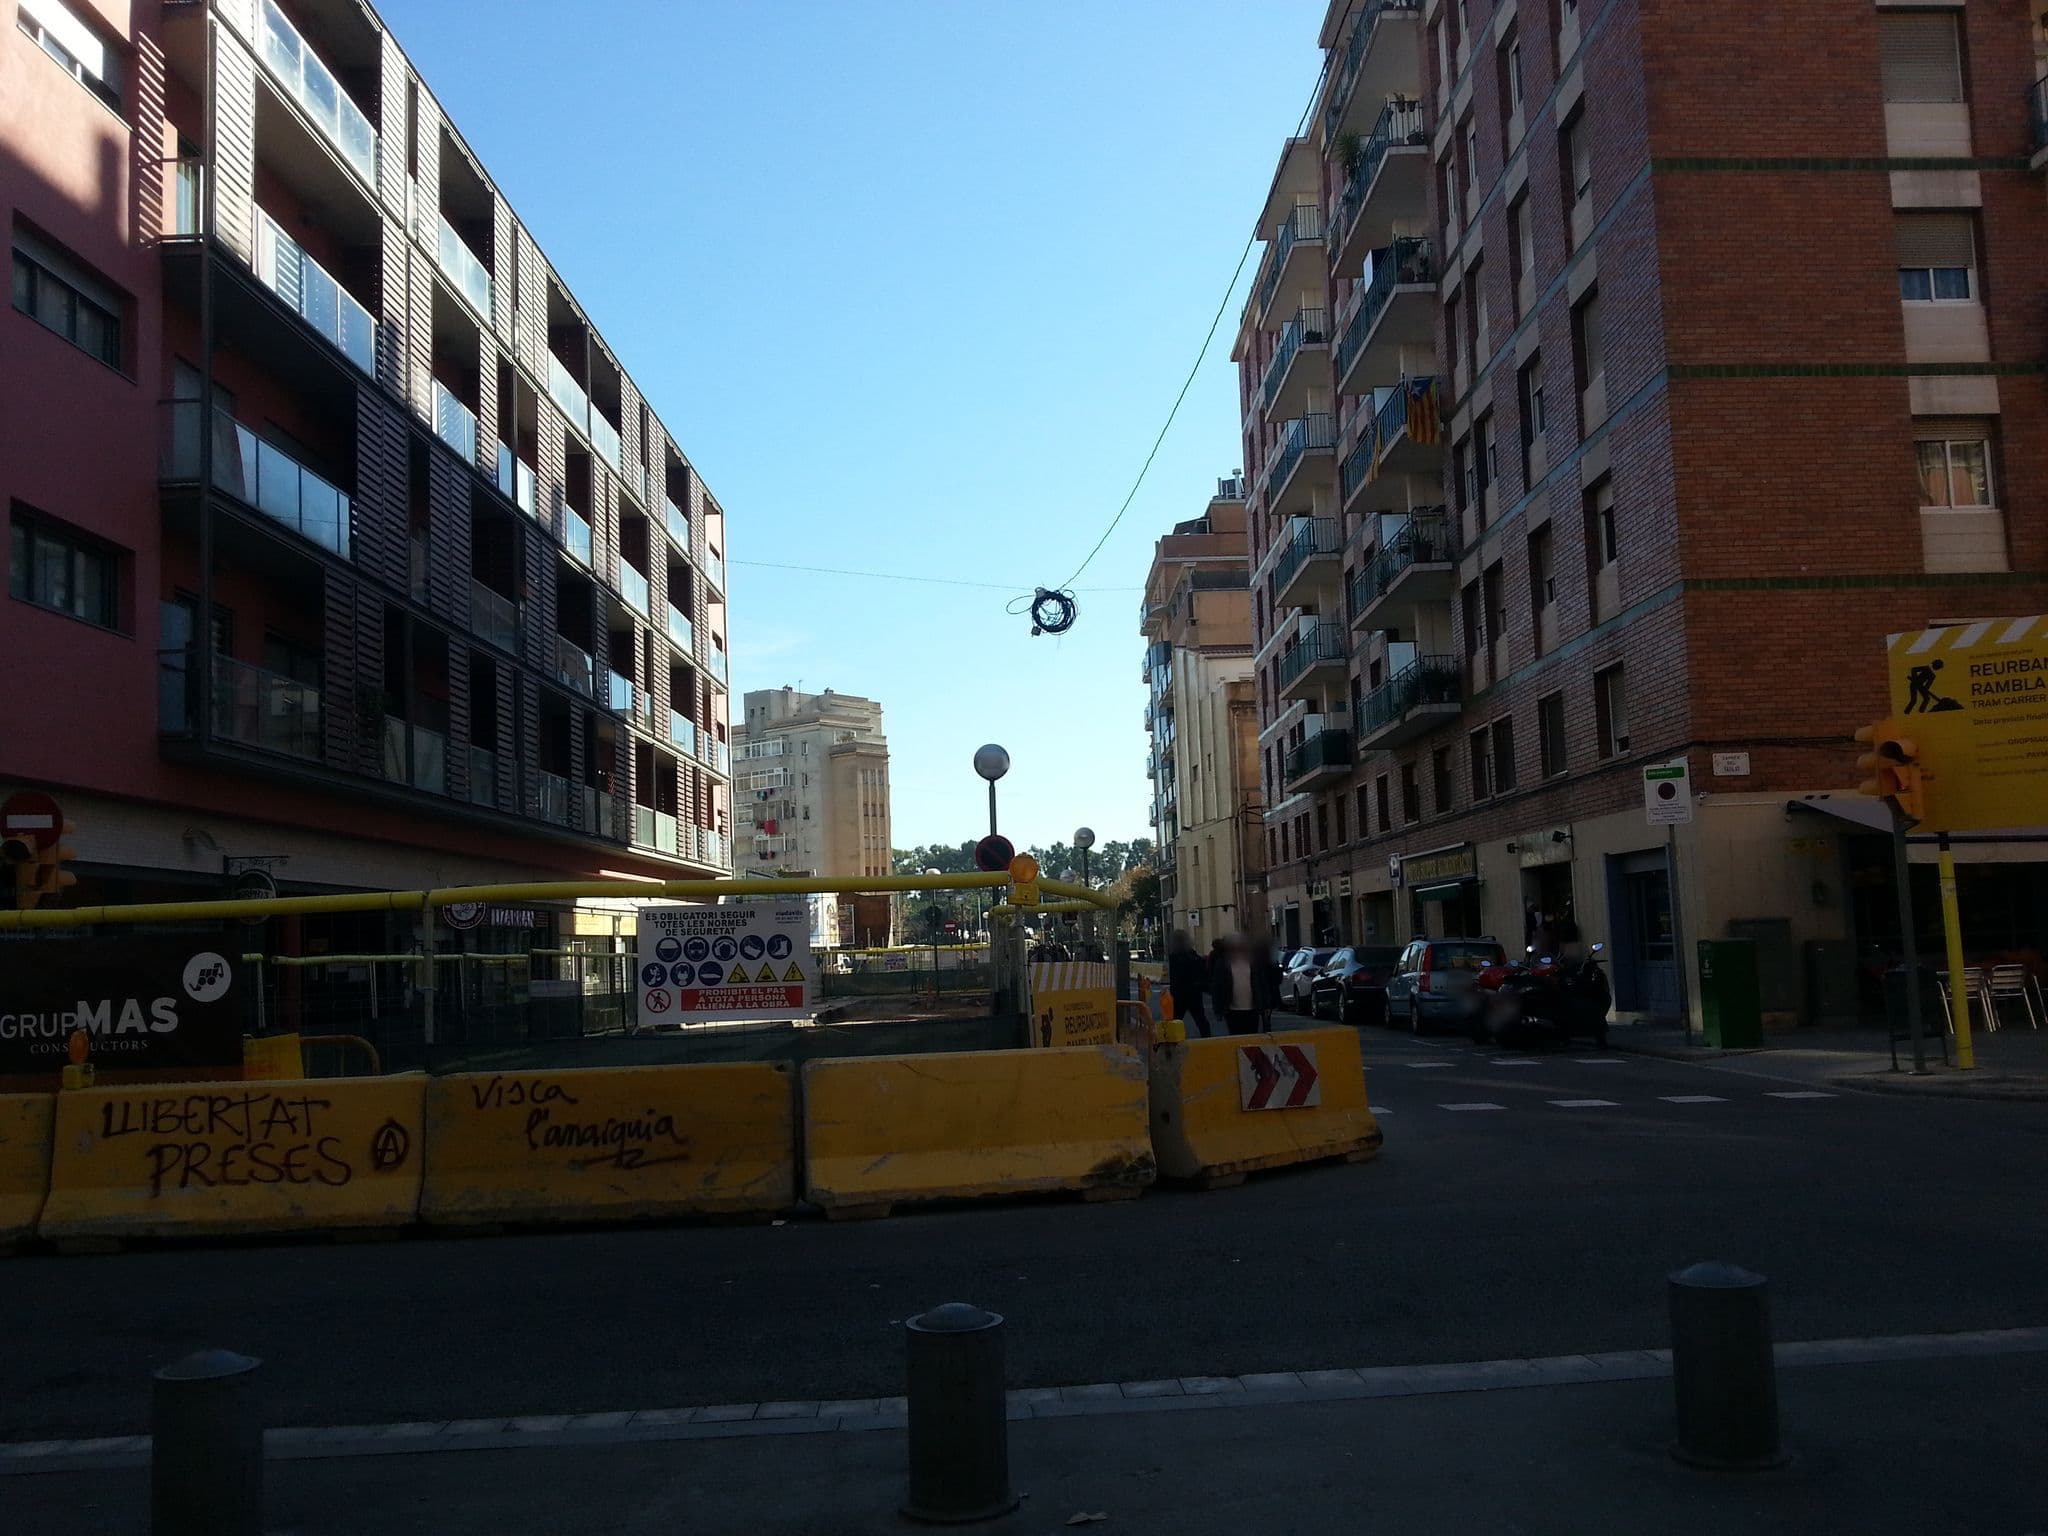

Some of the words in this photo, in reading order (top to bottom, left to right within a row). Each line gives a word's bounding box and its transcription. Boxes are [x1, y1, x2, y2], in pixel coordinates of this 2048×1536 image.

[1971, 676, 2046, 696] RAMBLA
[1972, 698, 2001, 709] TRAM
[2004, 693, 2047, 706] CARRER
[645, 912, 659, 921] ES
[660, 911, 718, 921] OBLIGATORI
[721, 910, 756, 919] SEGUIR
[654, 920, 685, 928] TOTES
[687, 920, 706, 928] LES
[708, 919, 748, 927] NORMES
[681, 927, 736, 936] SEGURETAT
[698, 988, 749, 996] PROHIBIT
[751, 987, 764, 995] EL
[767, 986, 786, 994] PAS
[698, 995, 706, 1003] A
[708, 994, 735, 1002] TOTA
[737, 993, 787, 1001] PERSONA
[695, 1002, 734, 1010] ALIENA
[735, 1001, 743, 1009] A
[745, 1001, 759, 1009] LA
[761, 1000, 790, 1008] OBRA
[0, 997, 179, 1039] GRUPMAS
[30, 1038, 150, 1055] CONSUCTORS
[101, 1091, 331, 1143] LLIBERTAT
[145, 1136, 352, 1199] PRESES
